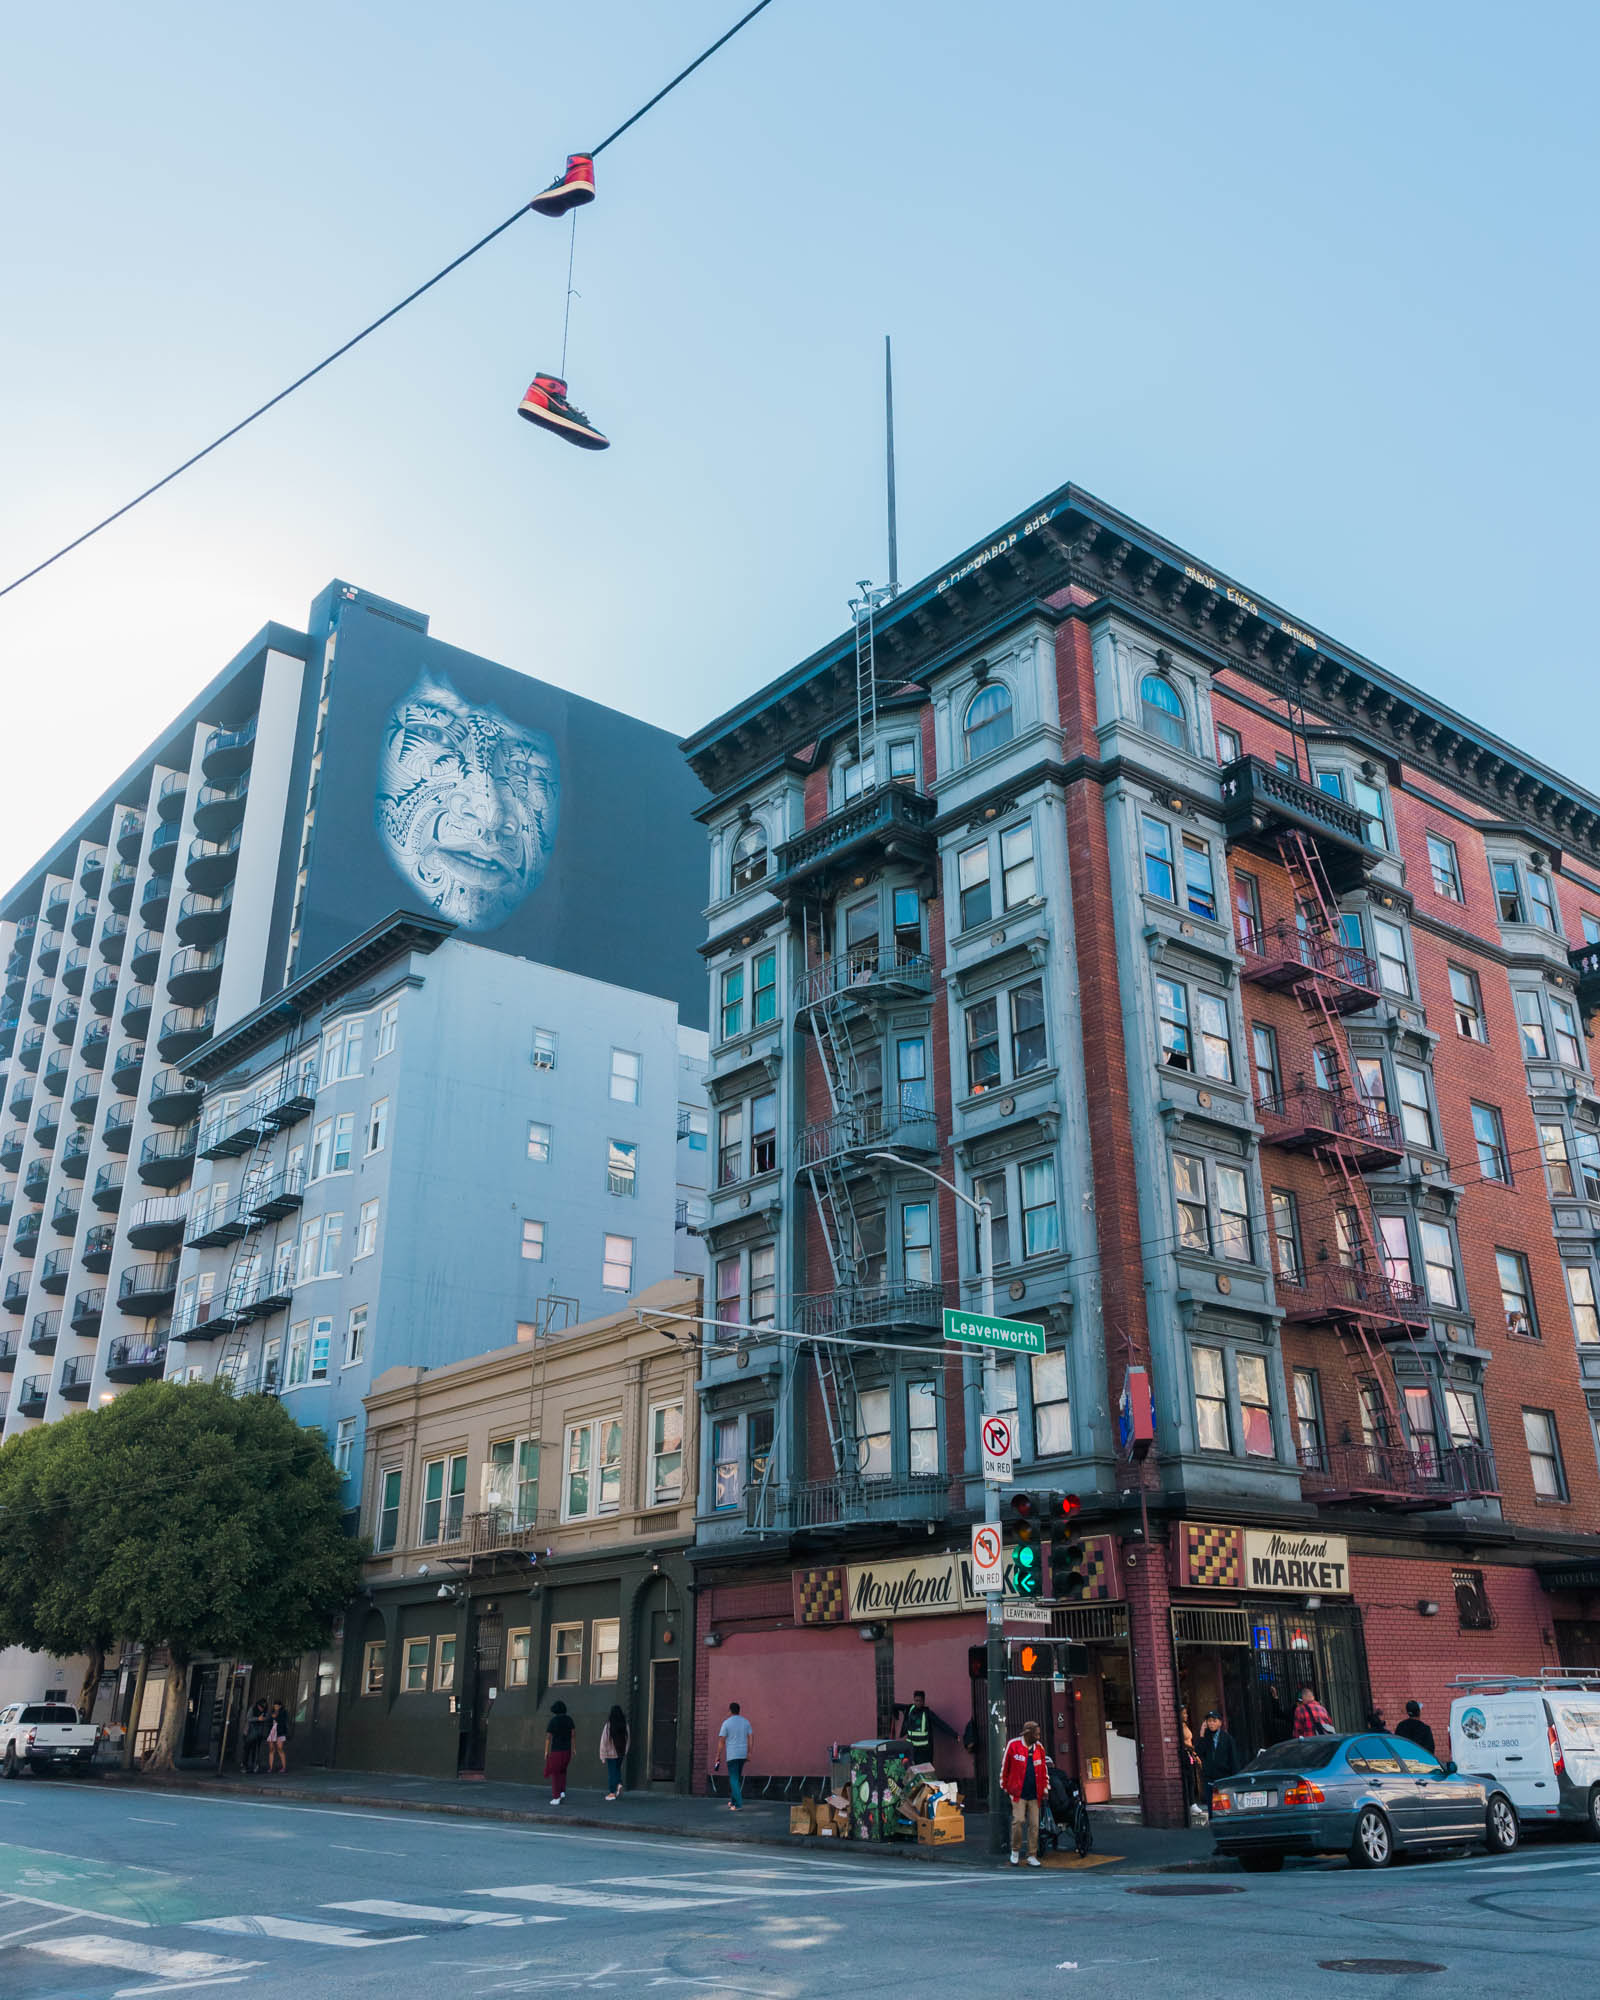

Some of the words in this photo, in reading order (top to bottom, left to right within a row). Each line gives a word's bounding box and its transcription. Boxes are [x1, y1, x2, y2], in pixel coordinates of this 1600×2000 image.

[951, 1316, 1038, 1347] Leavenworth
[985, 1460, 995, 1472] ON
[997, 1462, 1011, 1474] RED
[1265, 1534, 1329, 1560] Maryland
[975, 1574, 985, 1585] ON
[986, 1572, 1000, 1584] RED
[1252, 1557, 1345, 1589] MARKET
[851, 1565, 953, 1614] Maryland
[1006, 1607, 1048, 1621] LEAVENWORTH
